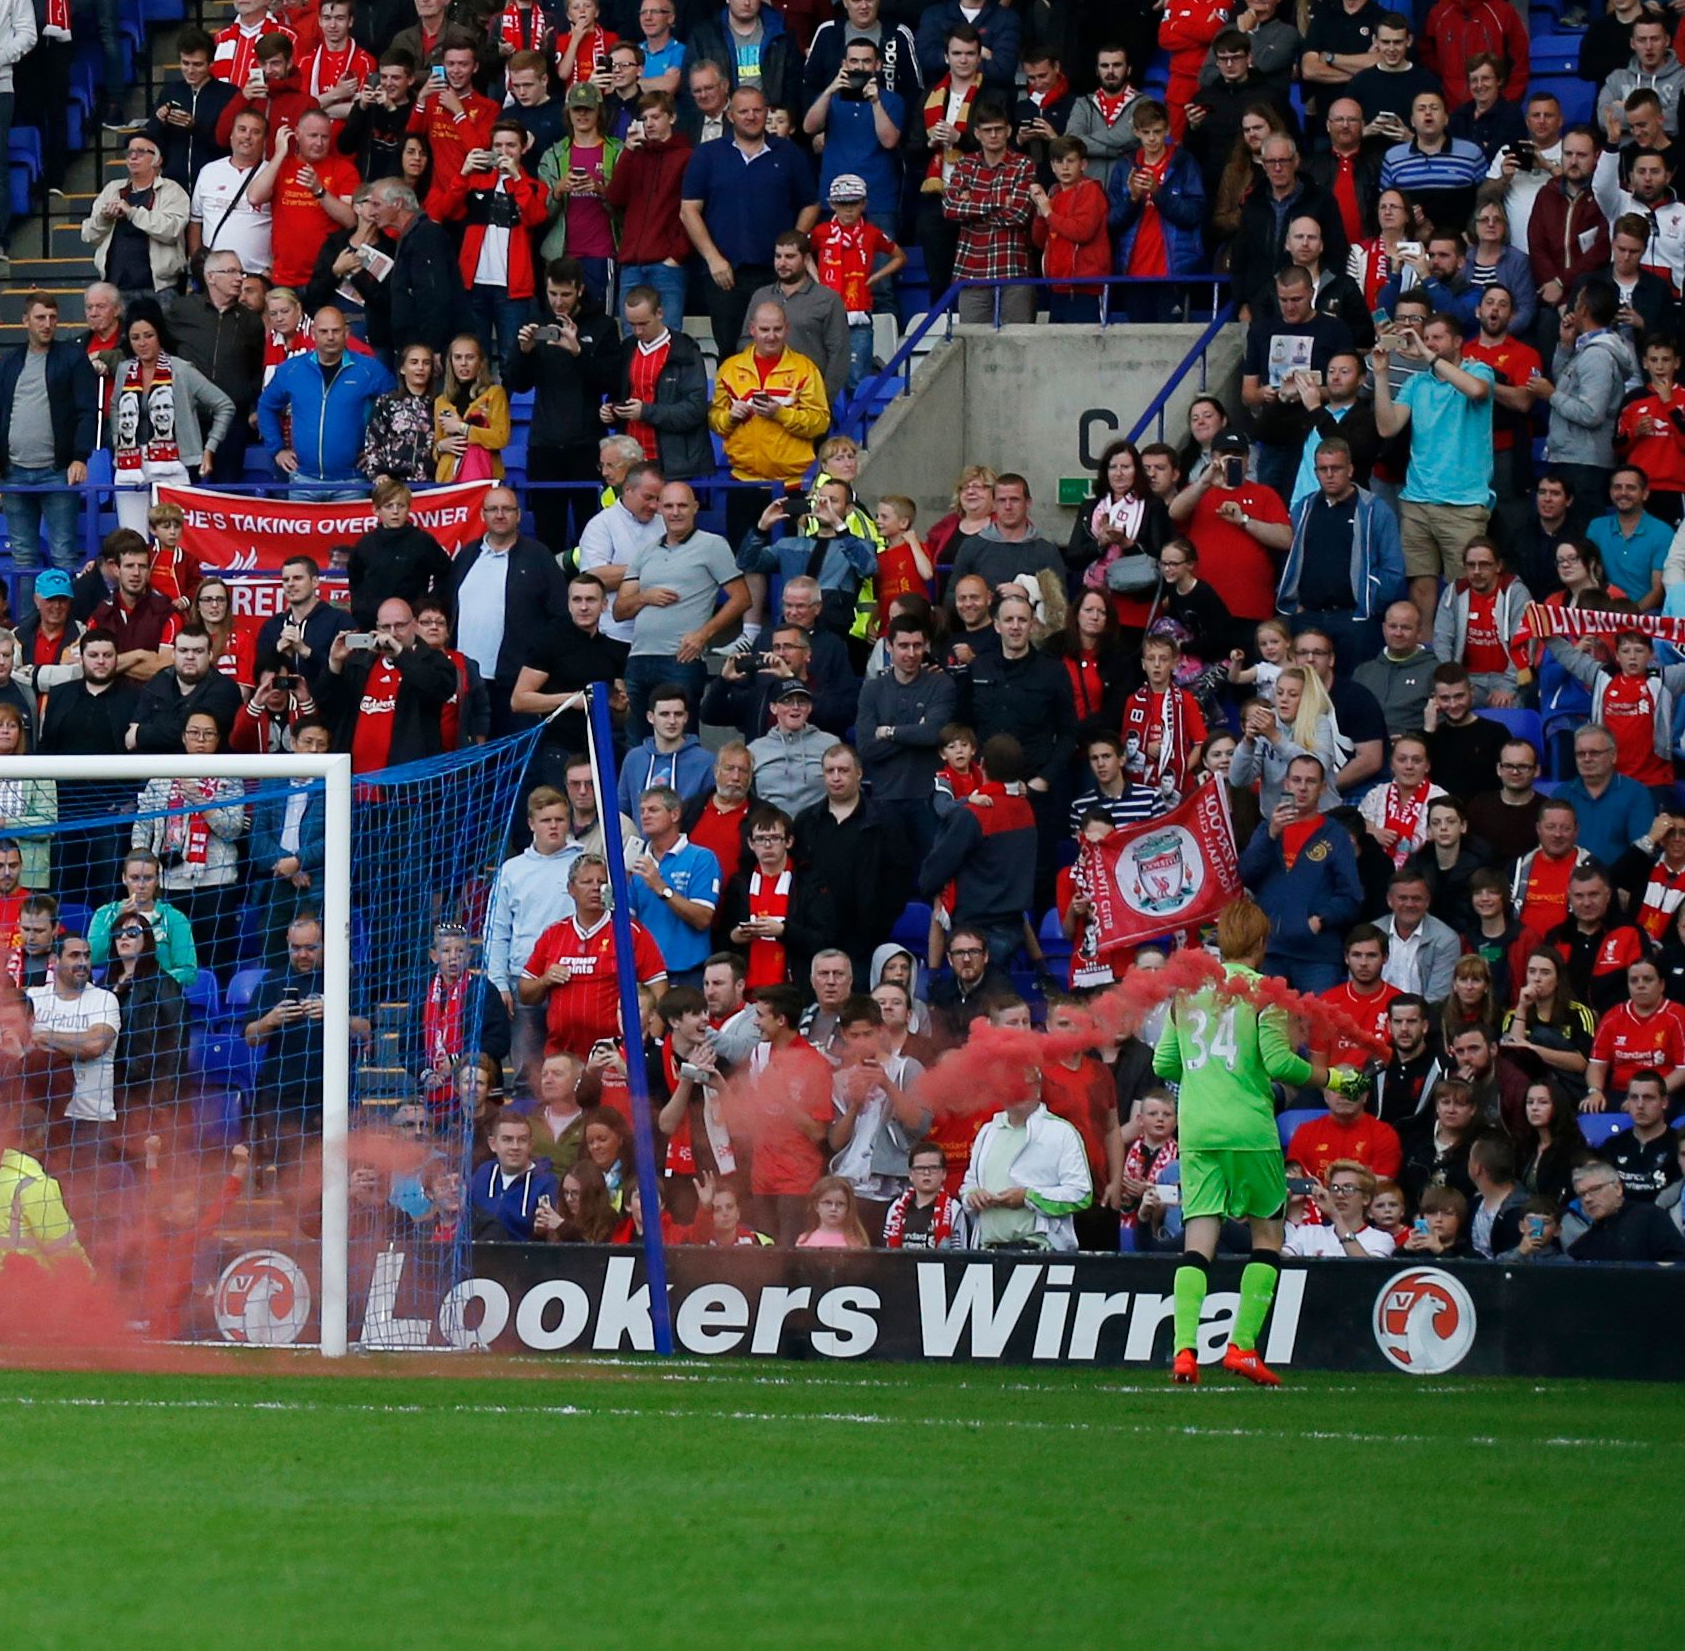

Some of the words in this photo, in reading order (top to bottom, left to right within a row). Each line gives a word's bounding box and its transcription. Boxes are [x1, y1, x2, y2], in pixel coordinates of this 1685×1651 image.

[882, 39, 897, 91] adida
[1077, 408, 1118, 470] C
[230, 513, 312, 535] TAKING
[317, 515, 378, 535] OVER
[1547, 604, 1666, 638] LIVERPOOL
[567, 965, 595, 975] aints
[1186, 1005, 1238, 1071] 34
[360, 1252, 881, 1354] Lookers
[916, 1262, 1308, 1364] Wirral
